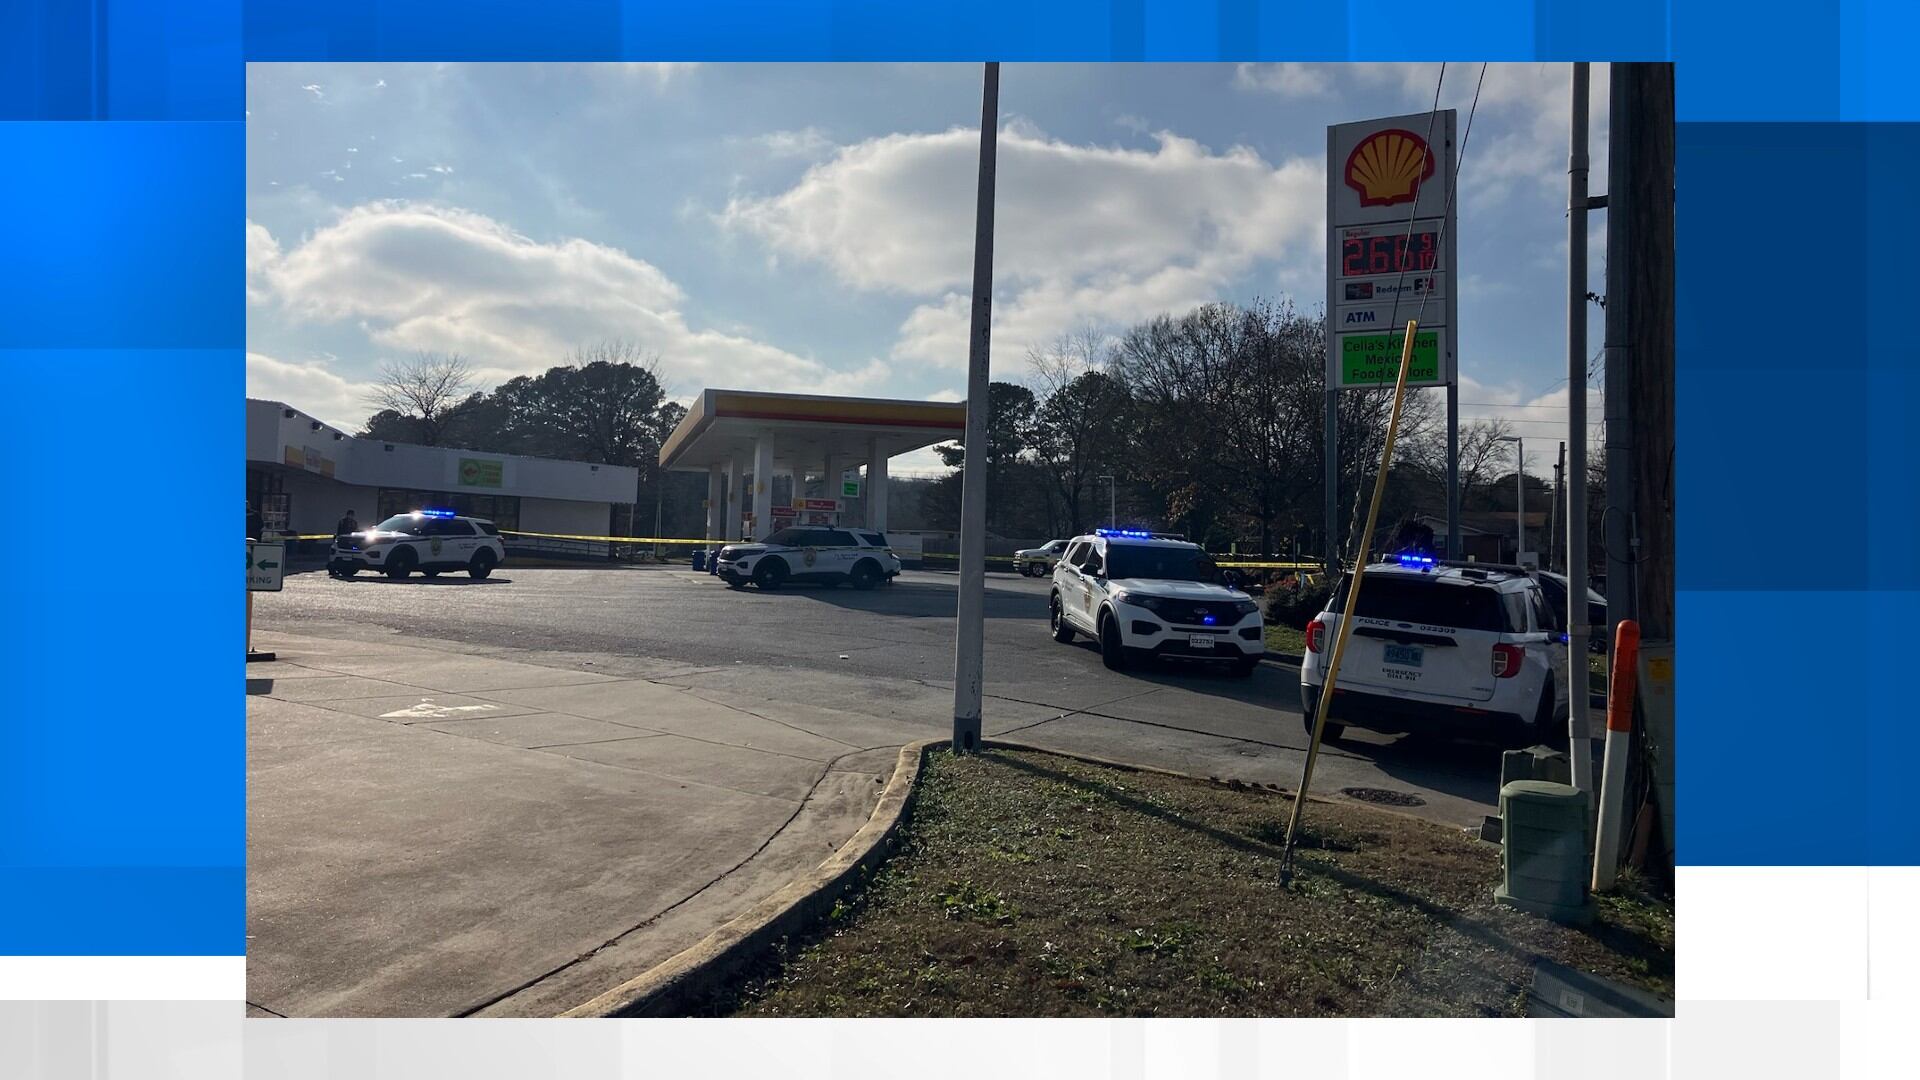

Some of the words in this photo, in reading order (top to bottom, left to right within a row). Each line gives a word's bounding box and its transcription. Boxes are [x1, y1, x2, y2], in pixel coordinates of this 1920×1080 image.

[1375, 285, 1412, 294] Redeem
[1345, 311, 1375, 323] ATM
[1365, 353, 1417, 365] Mexicn
[1352, 368, 1383, 379] Food
[1386, 368, 1396, 378] &
[1408, 367, 1434, 377] ore
[1358, 618, 1391, 627] POLICE
[1382, 667, 1423, 678] EMERGENCY
